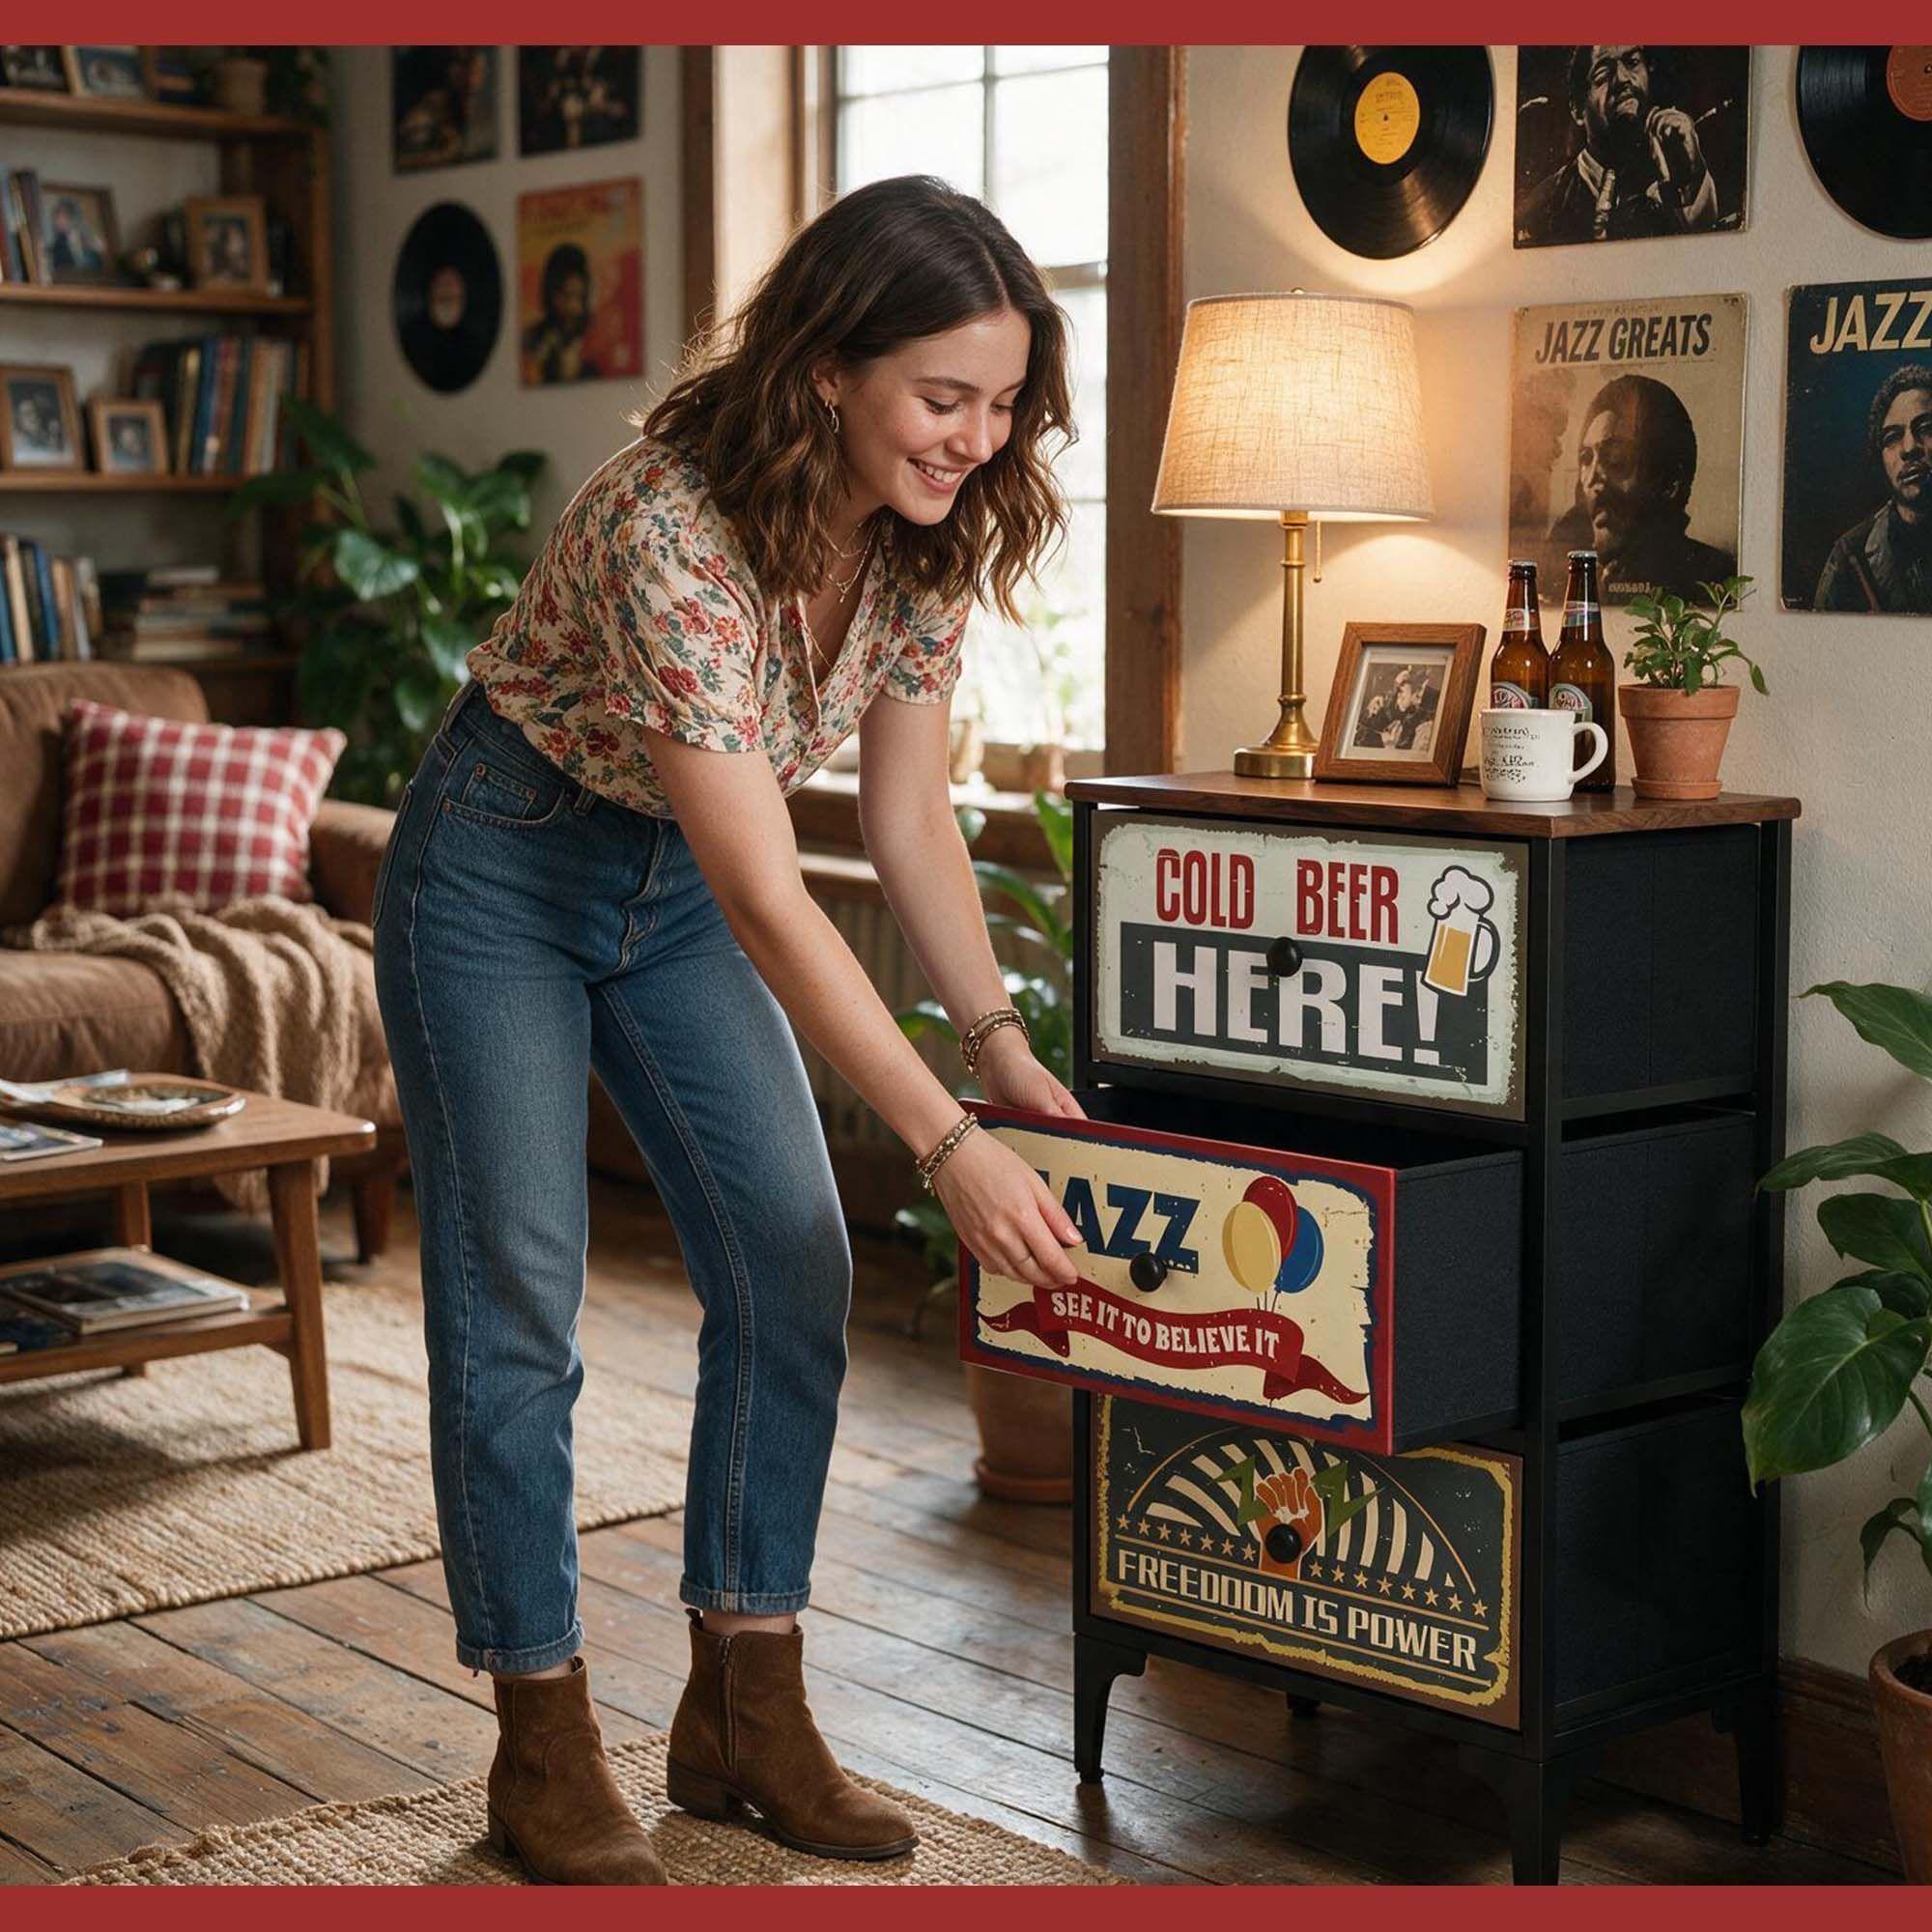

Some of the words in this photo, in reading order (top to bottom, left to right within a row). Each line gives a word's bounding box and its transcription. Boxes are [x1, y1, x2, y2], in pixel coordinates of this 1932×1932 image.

[1535, 319, 1605, 363] JAZZ
[1608, 313, 1713, 360] GREATS
[1810, 291, 1932, 355] JAZZ
[1156, 848, 1254, 929] COLD
[1296, 859, 1399, 944] BEER
[1153, 941, 1440, 1066] HERE!
[1036, 1169, 1201, 1274] AZZ
[1051, 1292, 1093, 1321] SEE
[1096, 1295, 1120, 1332] IT
[1122, 1311, 1151, 1345] TO
[1155, 1321, 1251, 1353] BELIEVE
[1255, 1327, 1280, 1359] IT
[1301, 1594, 1339, 1635] IS
[1347, 1605, 1477, 1671] POWER
